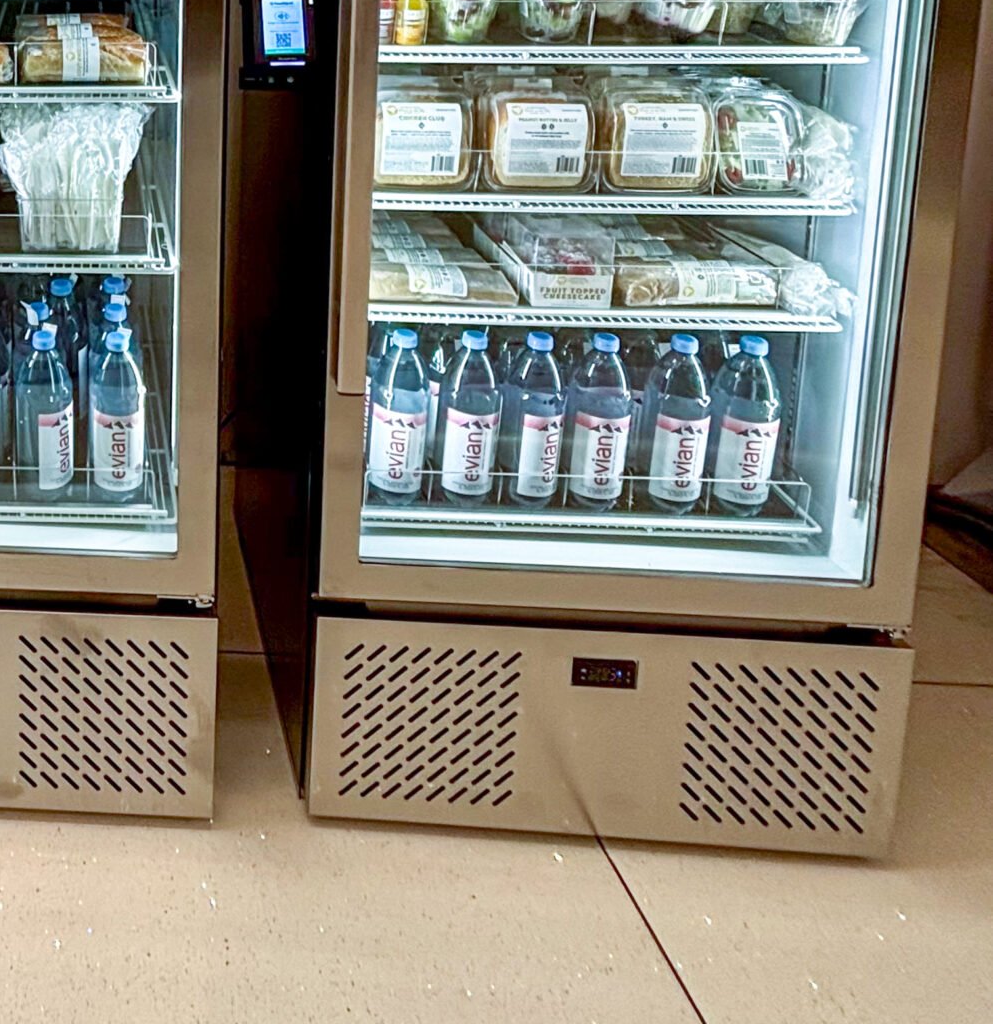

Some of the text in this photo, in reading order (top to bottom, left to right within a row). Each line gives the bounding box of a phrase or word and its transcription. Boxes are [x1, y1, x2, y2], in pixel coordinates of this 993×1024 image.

[57, 429, 70, 473] evian
[109, 431, 127, 479] evian
[386, 430, 407, 479] evian
[463, 430, 482, 482] evian
[540, 432, 559, 483] evian
[592, 436, 614, 485] evian
[674, 438, 695, 488] evian
[739, 441, 762, 491] evian
